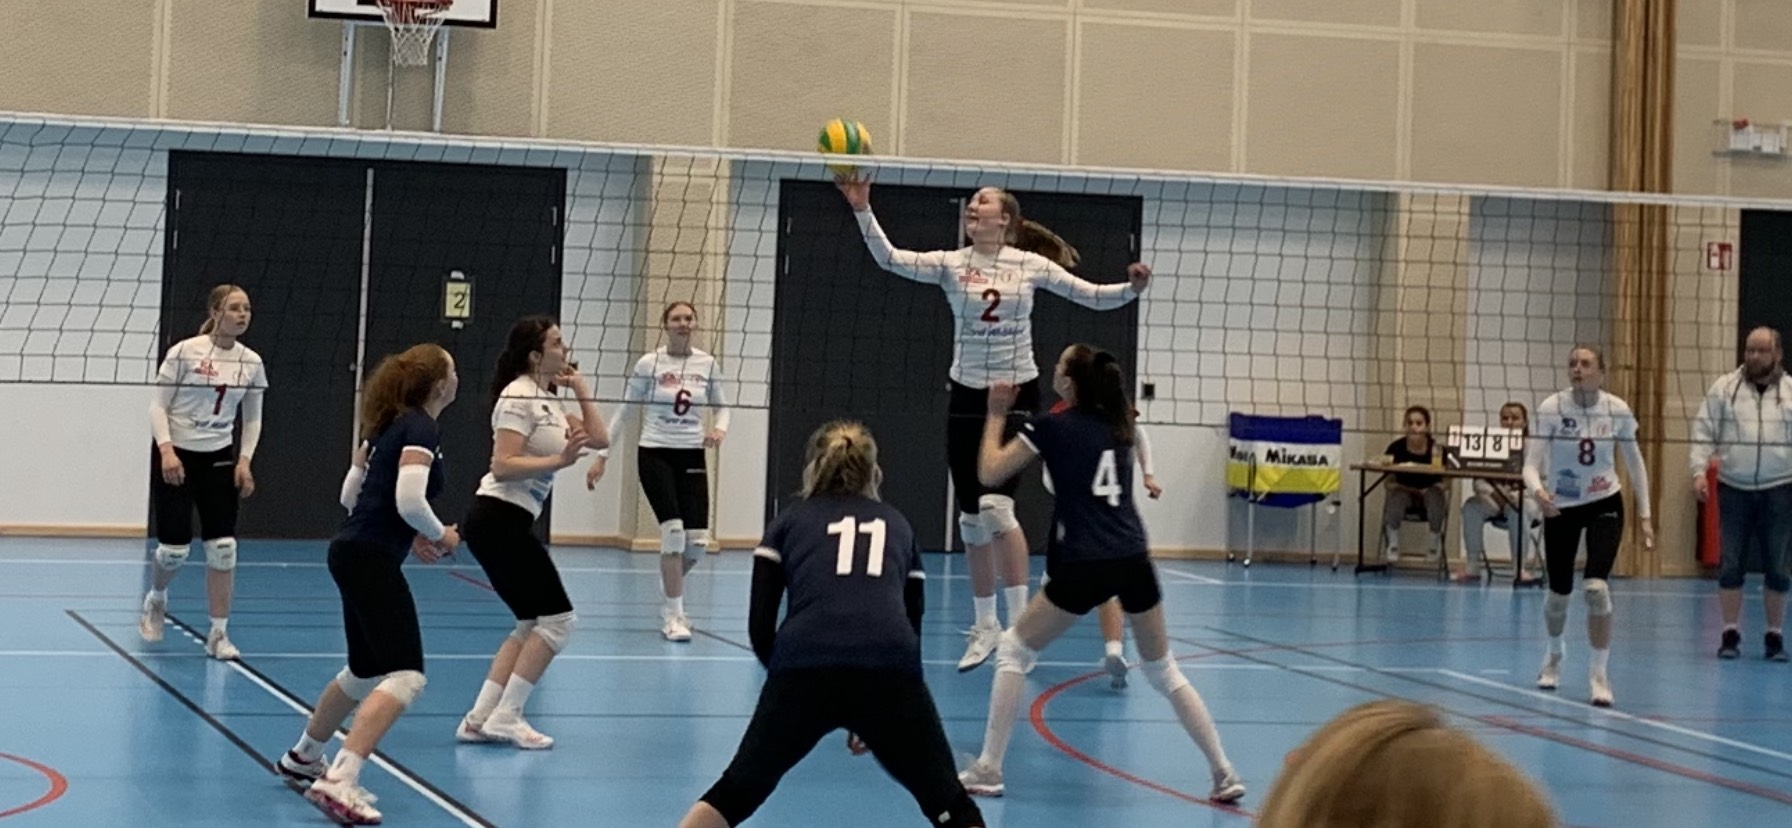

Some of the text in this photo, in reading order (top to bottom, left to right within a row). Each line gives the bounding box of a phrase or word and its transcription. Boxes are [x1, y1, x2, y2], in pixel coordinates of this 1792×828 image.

[454, 291, 465, 309] 2
[980, 289, 1001, 322] 2
[673, 389, 692, 416] 6
[1464, 434, 1481, 451] 13
[1493, 434, 1502, 452] 8
[1579, 438, 1595, 466] 8
[1091, 449, 1123, 507] 4
[827, 515, 887, 577] 11
